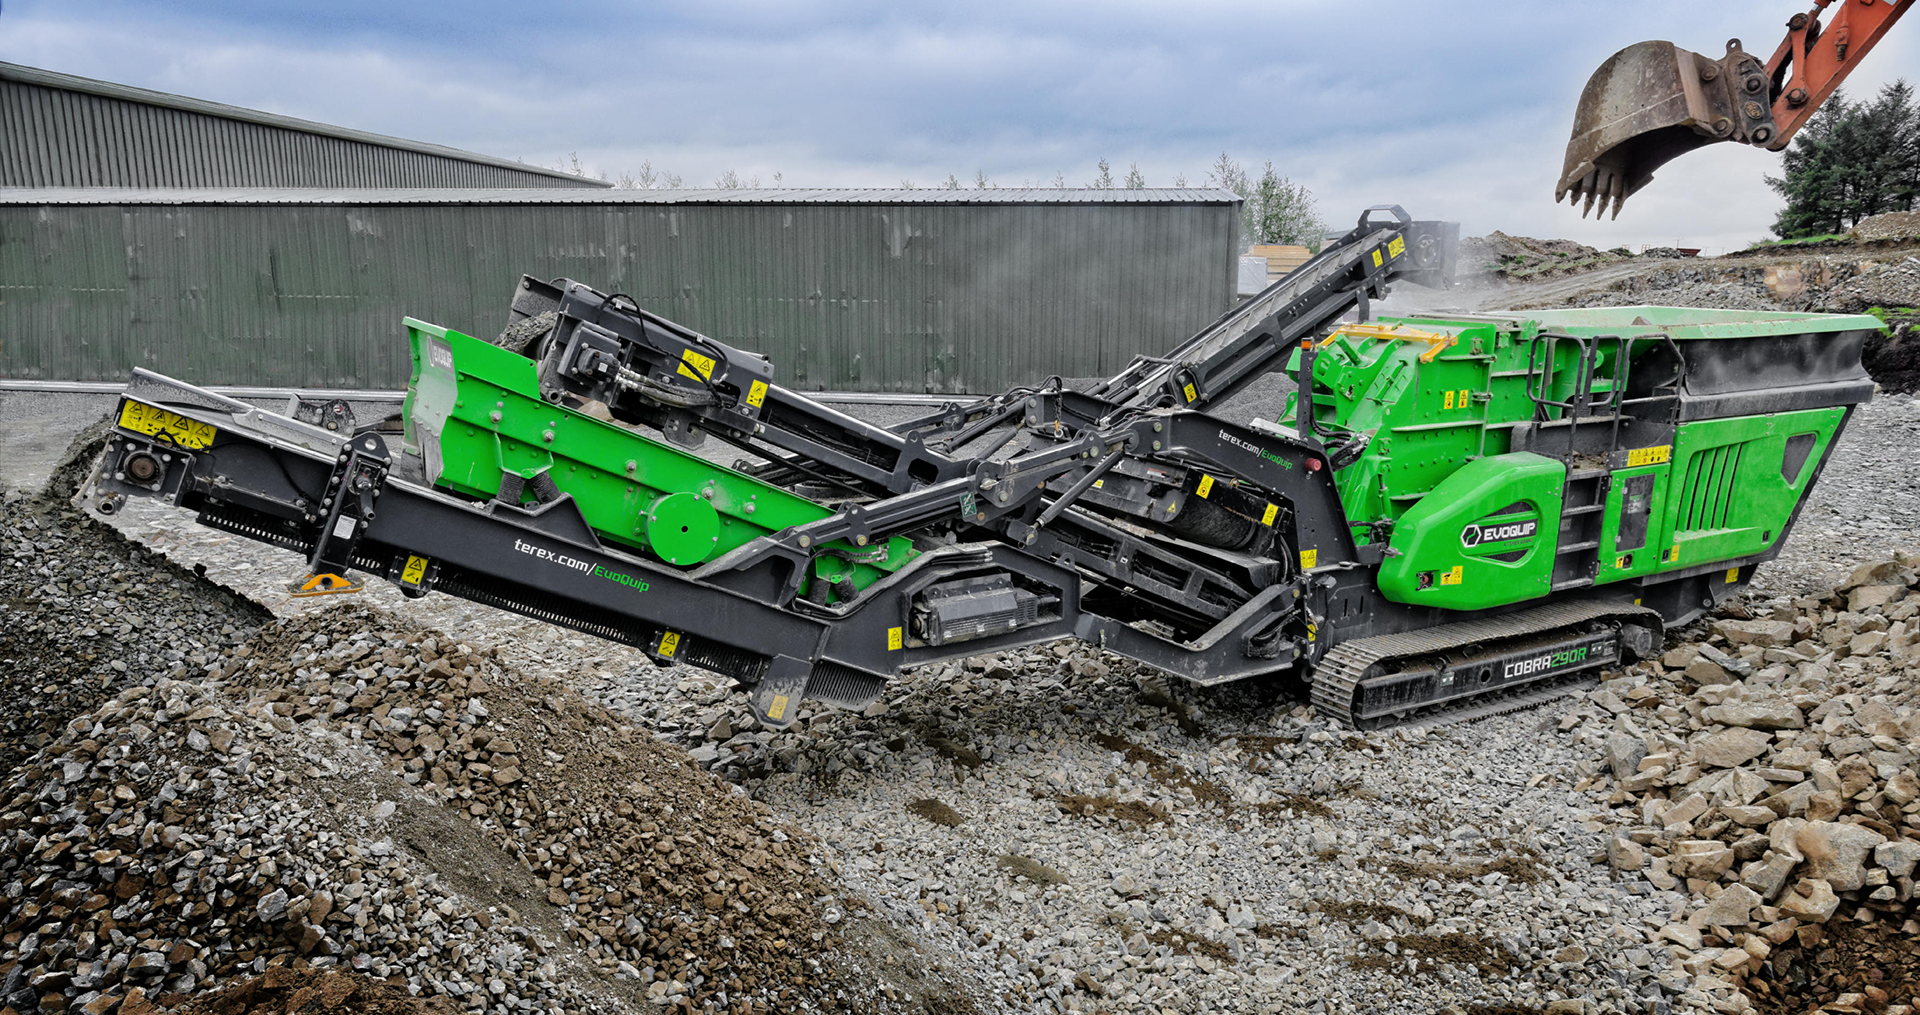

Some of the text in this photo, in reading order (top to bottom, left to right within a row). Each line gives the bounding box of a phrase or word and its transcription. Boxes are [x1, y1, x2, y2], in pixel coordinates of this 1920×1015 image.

[1218, 428, 1293, 471] terex.com/EvoQuip
[1483, 522, 1536, 541] EVOQUIP
[514, 538, 650, 593] terex.com/EvoQuip
